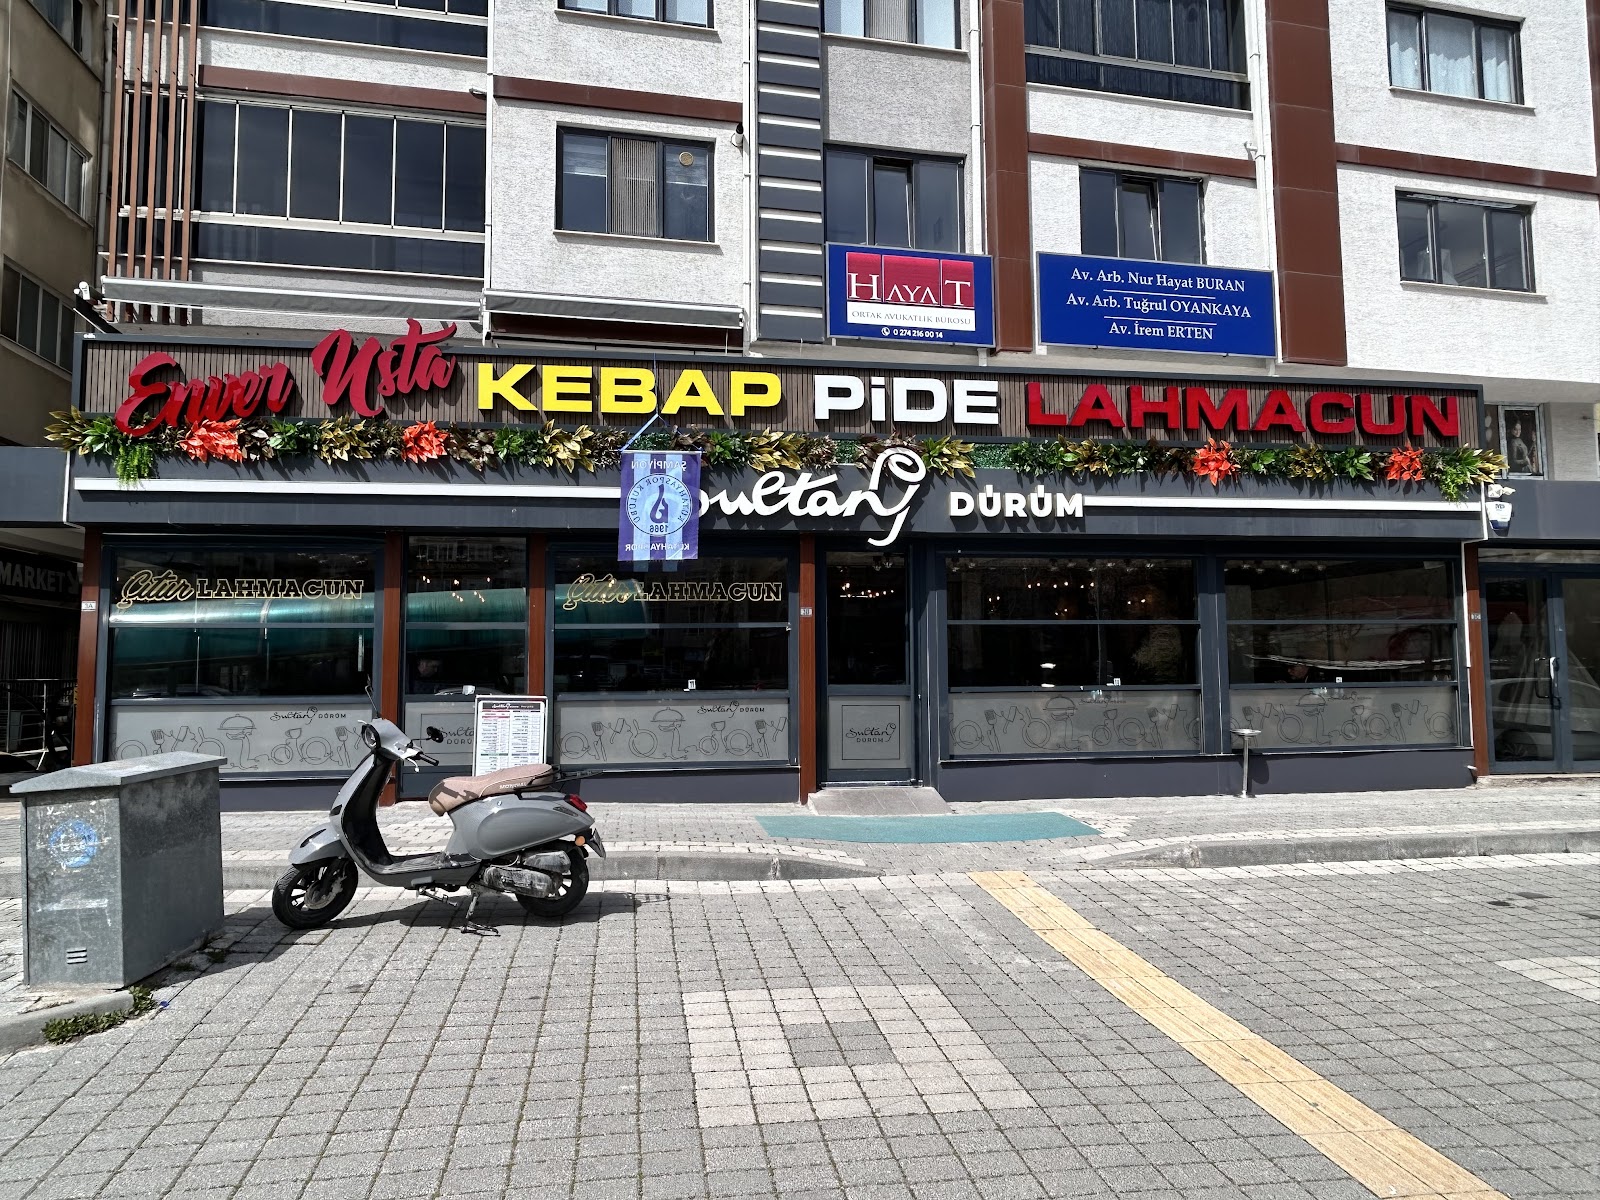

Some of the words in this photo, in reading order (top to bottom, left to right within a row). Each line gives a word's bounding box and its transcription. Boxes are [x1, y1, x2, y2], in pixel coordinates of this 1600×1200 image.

[848, 273, 971, 306] HAYAT
[1071, 268, 1093, 281] Av.
[1097, 269, 1124, 283] Arb.
[1128, 272, 1153, 285] Nur
[1157, 274, 1193, 291] Hayat
[1196, 278, 1245, 292] BURAN
[1066, 293, 1089, 306] Av.
[1092, 295, 1120, 308] Arb.
[1124, 296, 1167, 313] Tuğrul
[1170, 300, 1251, 318] OYANKAYA
[852, 311, 882, 320] ORTAK
[885, 313, 933, 323] AVUKATLIK
[900, 329, 911, 337] 274
[1109, 322, 1131, 335] Av.
[1134, 320, 1164, 337] İrem
[1167, 326, 1213, 340] ERTEN
[115, 351, 295, 437] Enver
[311, 317, 457, 417] Usta
[478, 362, 782, 416] KEBAP
[1026, 382, 1460, 437] LAHMACUN
[196, 578, 364, 599] LAHMACUN
[634, 582, 782, 601] LAHMACUN
[270, 705, 318, 725] Sultan
[697, 700, 740, 718] Sultan
[440, 727, 474, 739] Sulta
[845, 722, 896, 743] Sultan
